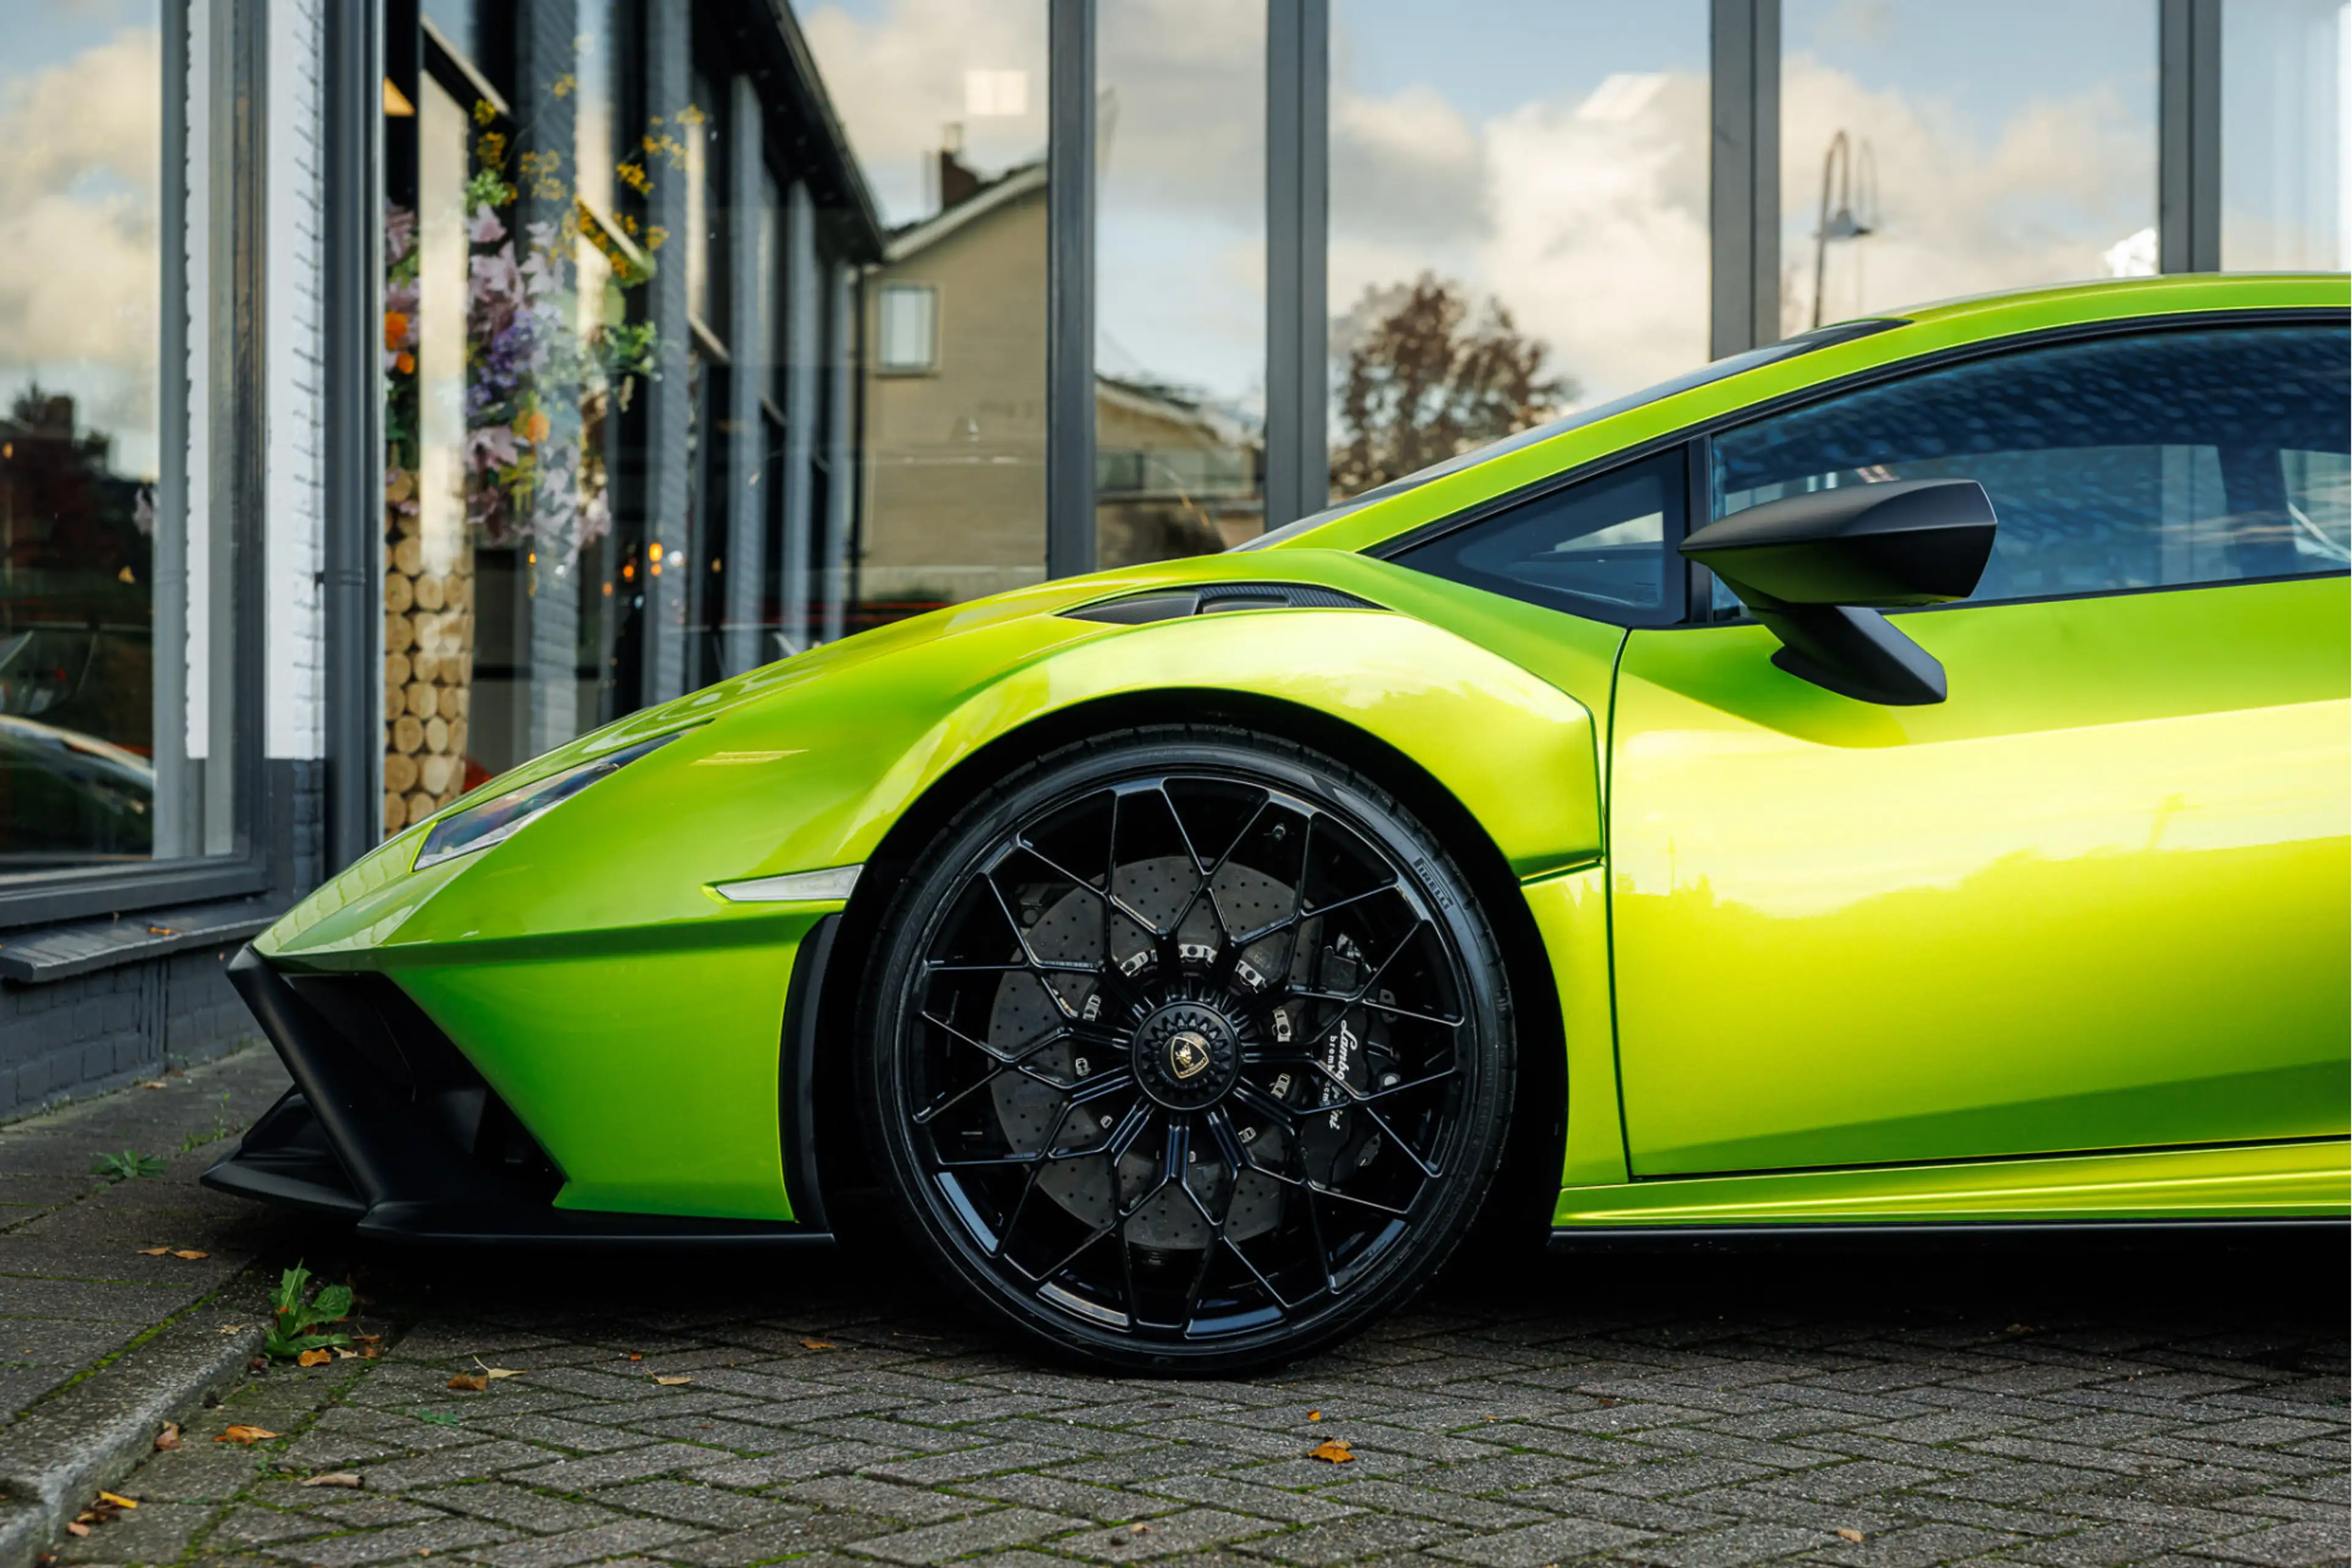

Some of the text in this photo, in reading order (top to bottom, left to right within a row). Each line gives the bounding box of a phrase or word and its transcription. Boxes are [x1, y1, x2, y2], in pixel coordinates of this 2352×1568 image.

[1413, 858, 1453, 910] PIRELLI
[1327, 1035, 1338, 1073] bremb
[1329, 1020, 1358, 1129] Lamboini
